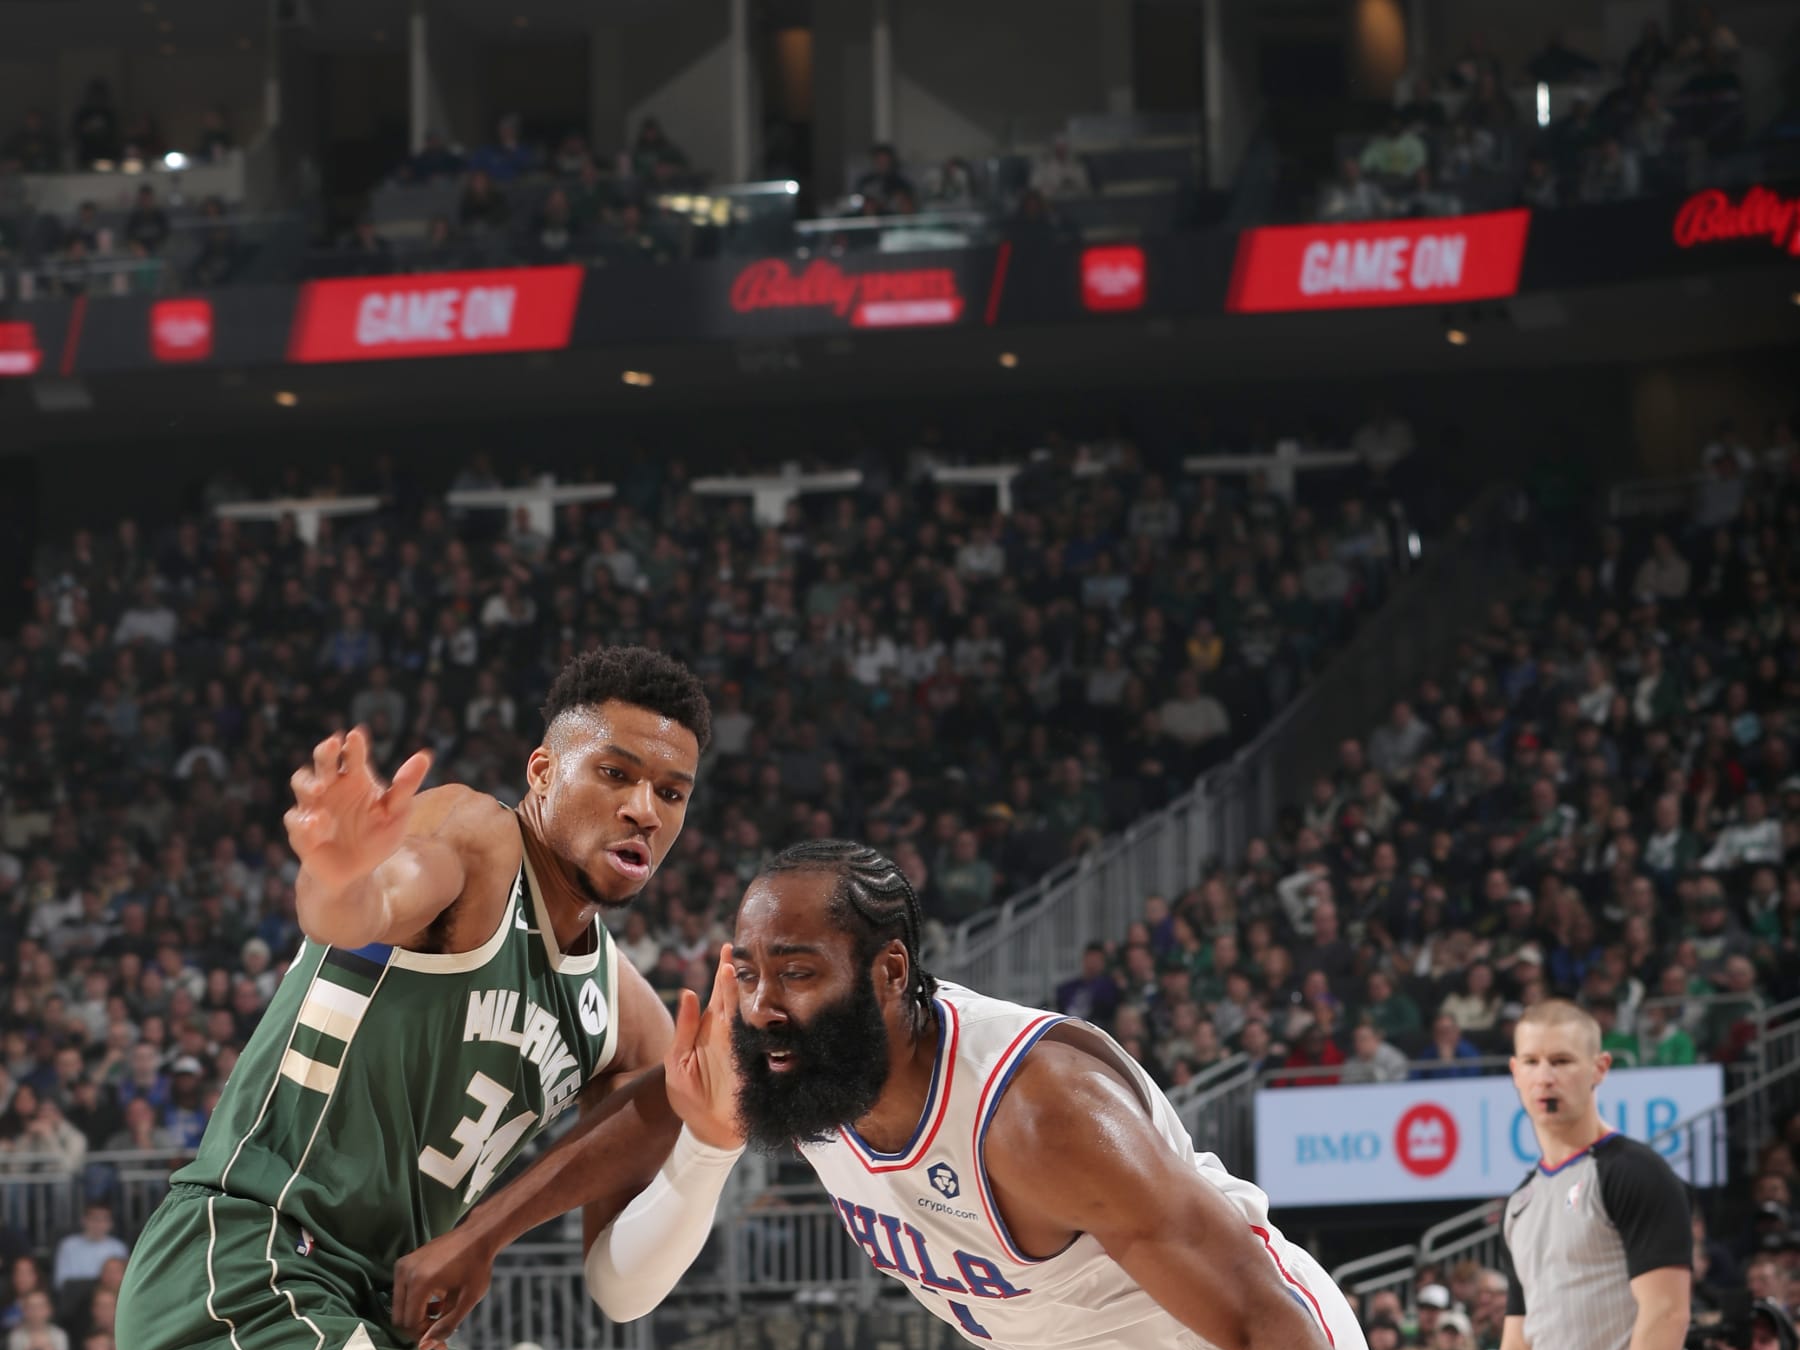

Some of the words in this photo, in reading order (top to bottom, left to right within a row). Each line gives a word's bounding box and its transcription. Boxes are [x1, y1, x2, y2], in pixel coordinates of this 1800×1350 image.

[1300, 236, 1409, 295] GAME
[1411, 233, 1467, 289] ON
[355, 292, 459, 345] GAME
[460, 286, 517, 338] ON
[1295, 1131, 1381, 1165] BMO
[917, 1196, 979, 1221] crypto.com
[829, 1194, 1032, 1299] HILA
